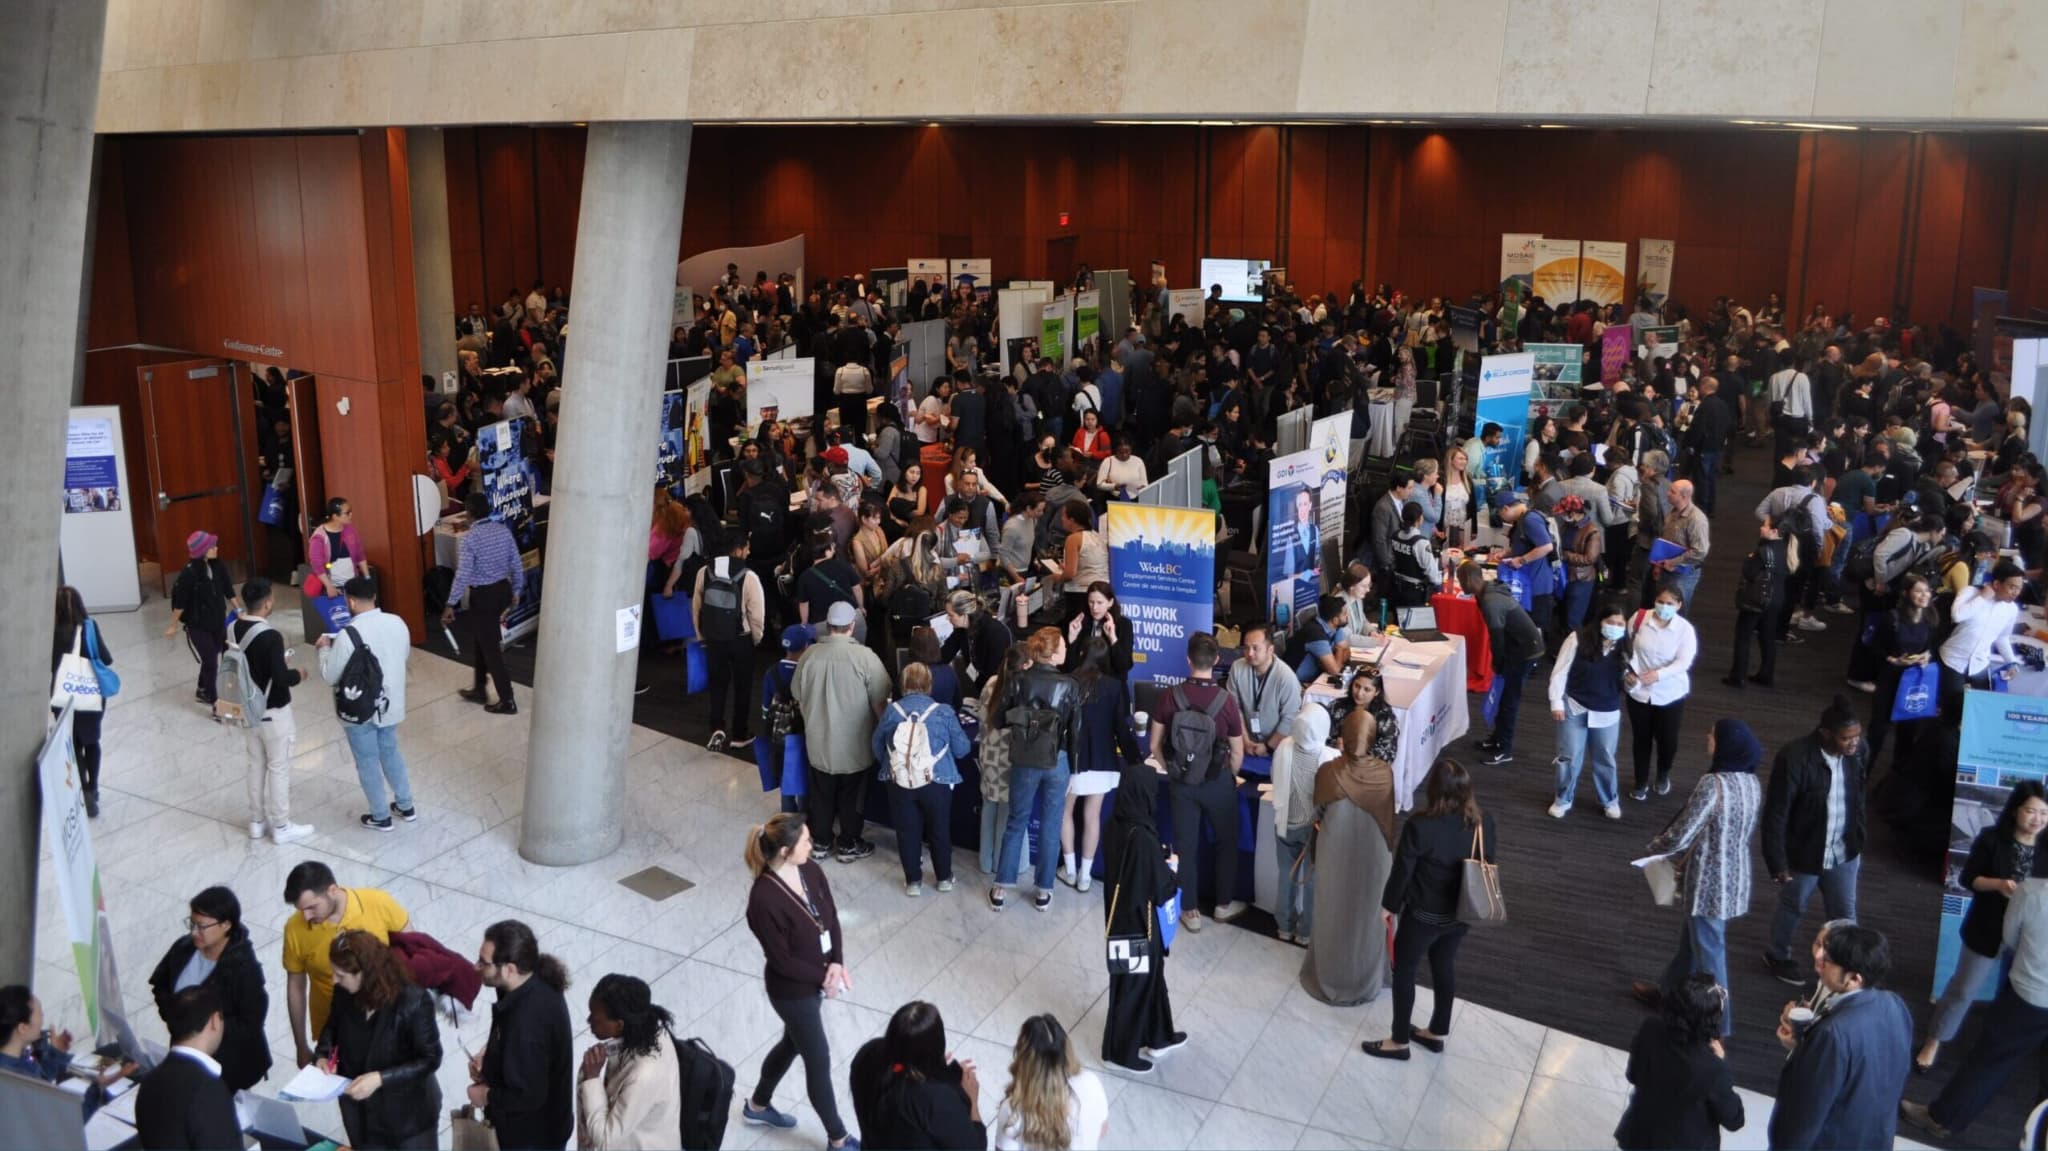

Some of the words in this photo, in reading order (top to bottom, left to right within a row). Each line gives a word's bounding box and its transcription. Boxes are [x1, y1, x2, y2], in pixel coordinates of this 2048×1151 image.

[496, 472, 521, 489] Where
[492, 486, 528, 508] Vancouver
[502, 503, 522, 520] Plays
[1392, 540, 1412, 555] POLICE
[1139, 561, 1182, 576] WorkBC
[1122, 580, 1141, 588] Centre
[1123, 571, 1157, 580] Employment
[1157, 574, 1178, 583] Services
[1178, 577, 1196, 585] Centre
[1120, 603, 1140, 618] IND
[1142, 604, 1178, 622] WORK
[1143, 621, 1185, 639] WORKS
[1137, 636, 1163, 652] YOU.
